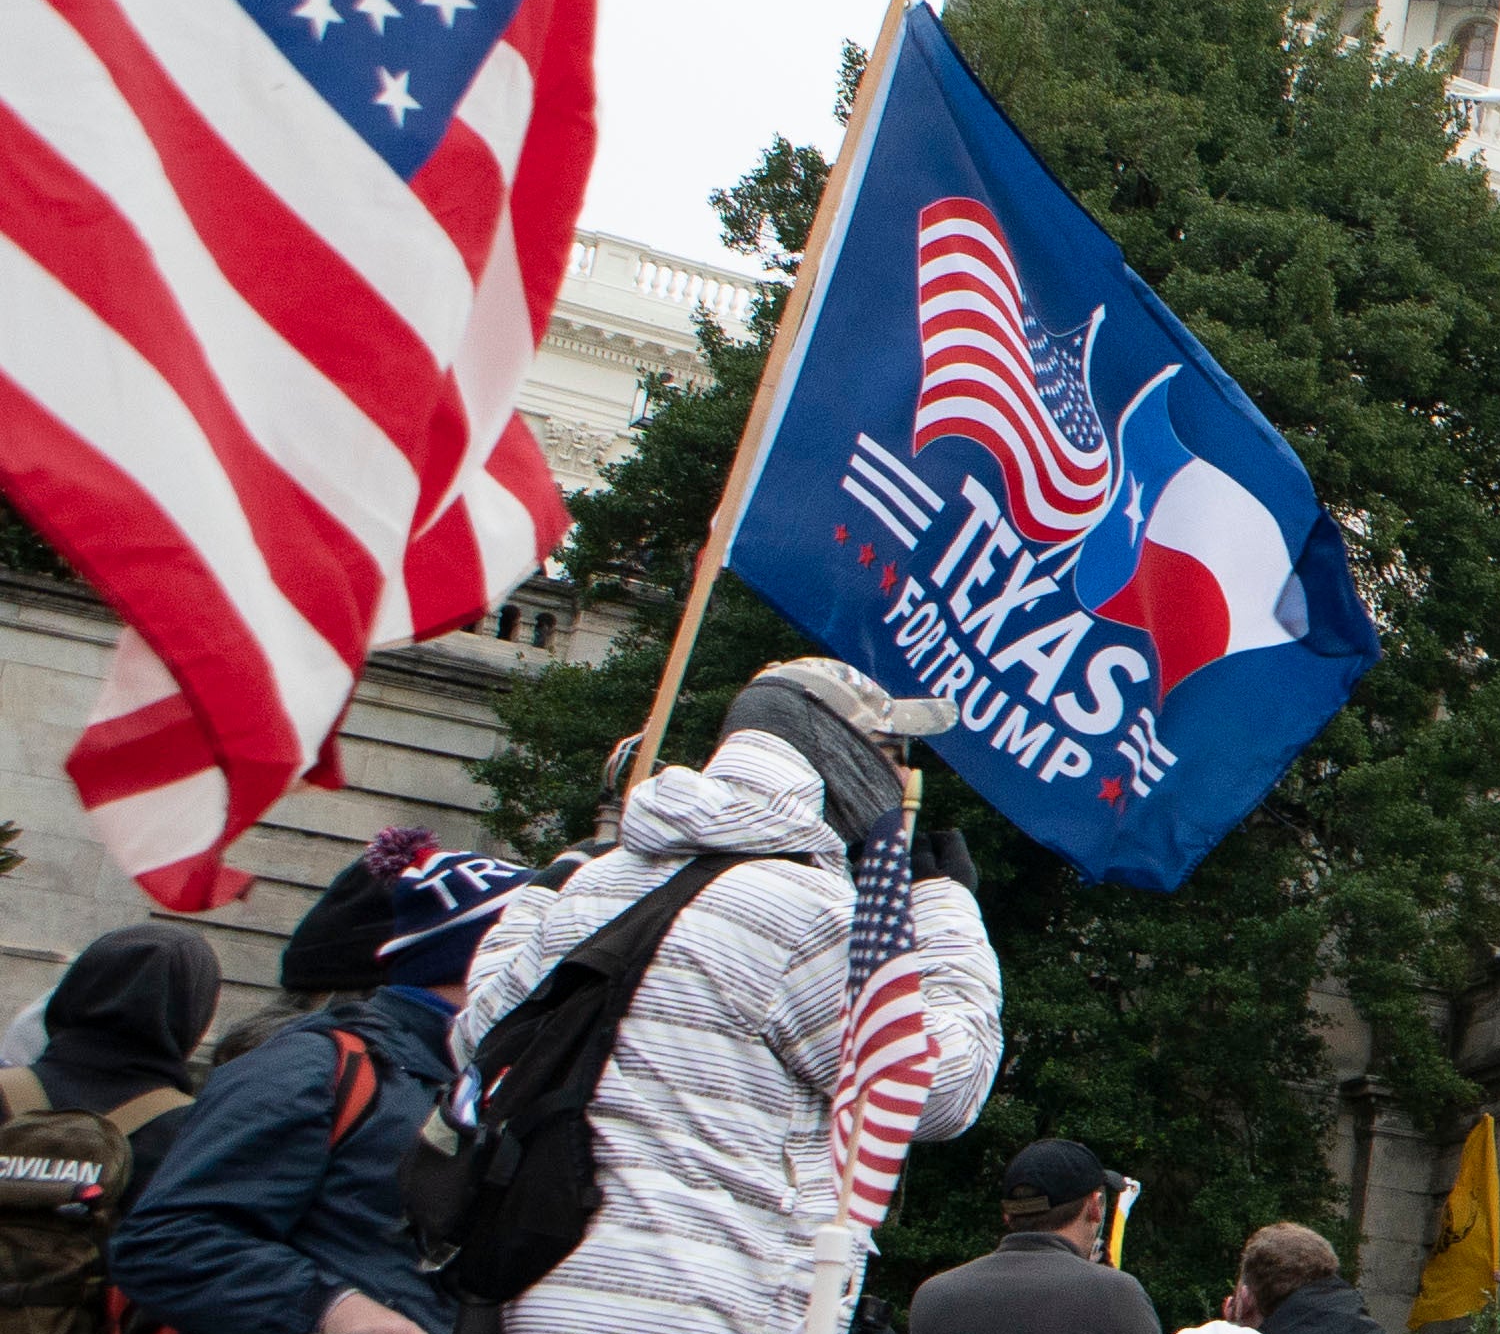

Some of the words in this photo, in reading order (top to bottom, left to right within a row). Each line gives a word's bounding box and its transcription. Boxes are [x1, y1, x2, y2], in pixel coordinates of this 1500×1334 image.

[930, 474, 1150, 735] TEXAS
[884, 576, 947, 669] FOR
[919, 637, 1092, 783] TRUMP
[414, 857, 528, 910] TR
[0, 1154, 103, 1184] CIVILIAN
